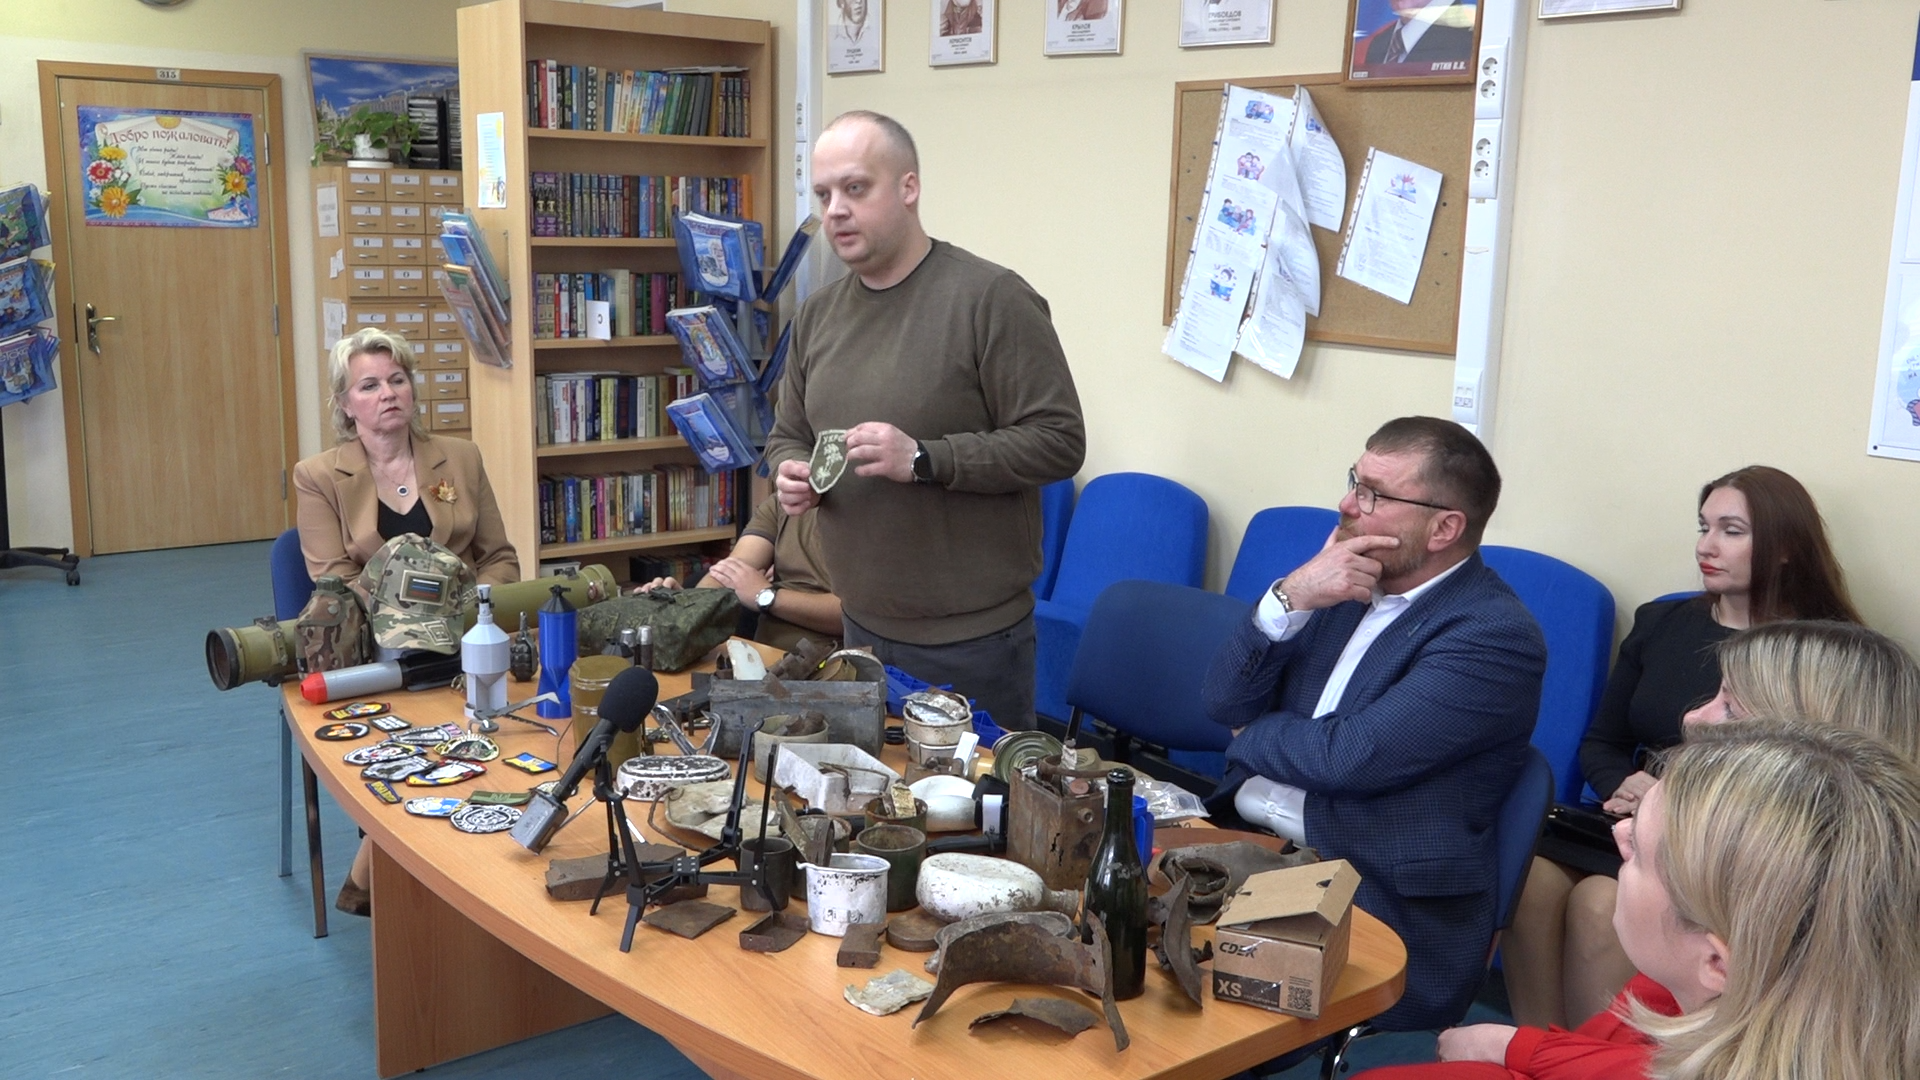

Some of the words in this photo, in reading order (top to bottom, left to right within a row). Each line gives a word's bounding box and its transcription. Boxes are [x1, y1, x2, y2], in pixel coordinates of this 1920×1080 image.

[1208, 10, 1242, 18] ГРИБОЕДОВ
[1431, 62, 1452, 71] ПУТИН
[159, 70, 177, 79] 315
[109, 130, 149, 145] Добро
[152, 130, 230, 149] пожаловать!
[1219, 941, 1257, 958] CDEK
[1217, 978, 1242, 997] XS
